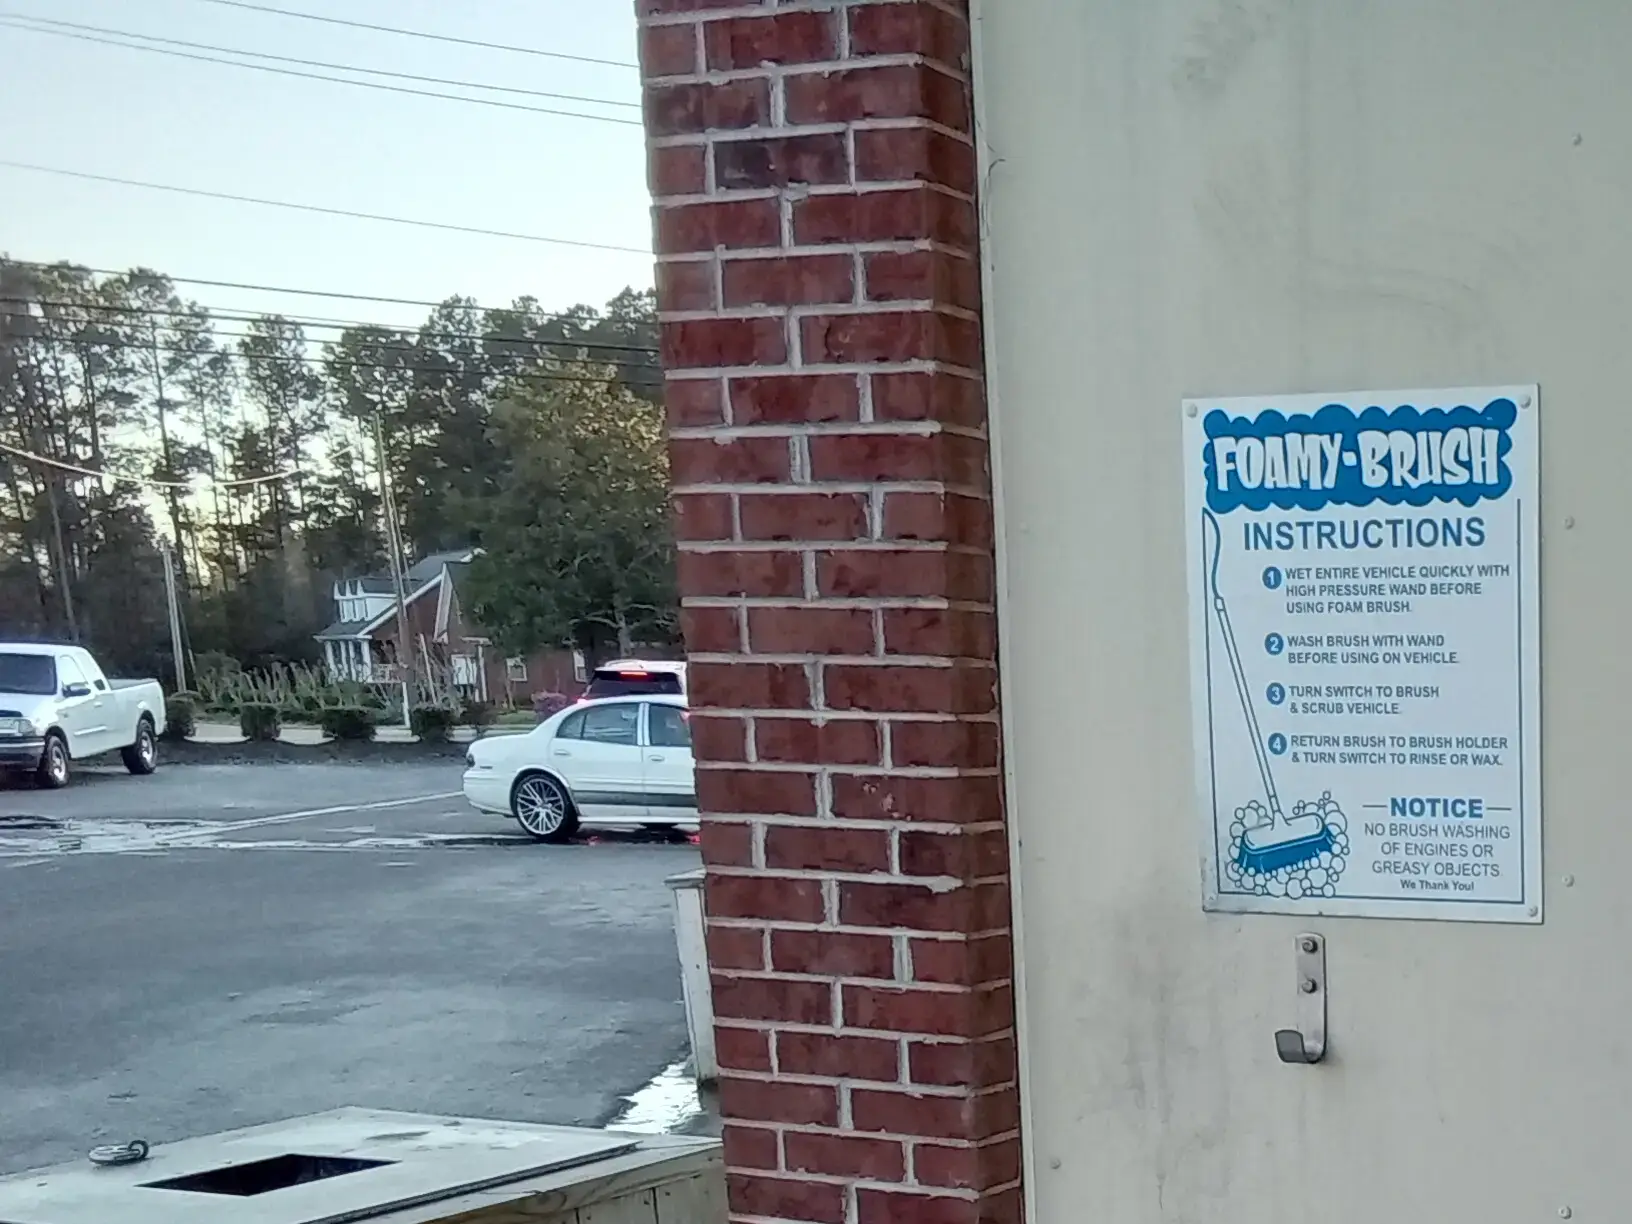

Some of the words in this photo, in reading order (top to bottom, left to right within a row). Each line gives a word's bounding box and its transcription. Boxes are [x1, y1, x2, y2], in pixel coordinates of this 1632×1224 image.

[1244, 517, 1485, 550] INSTRUCTIONS
[1285, 567, 1313, 580] WET
[1316, 567, 1360, 580] ENTIRE
[1363, 566, 1416, 579] VEHICLE
[1419, 565, 1474, 578] QUICKLY
[1477, 564, 1509, 577] WITH
[1286, 585, 1316, 597] HIGH
[1319, 584, 1387, 596] PRESSURE
[1389, 583, 1427, 595] WAND
[1430, 582, 1481, 595] BEFORE
[1286, 602, 1324, 614] USING
[1327, 602, 1364, 614] FOAM
[1287, 636, 1324, 648] WASH
[1327, 635, 1370, 648] BRUSH
[1372, 635, 1403, 647] WITH
[1406, 635, 1444, 647] WAND
[1288, 652, 1337, 664] BEFORE
[1341, 652, 1379, 664] USING
[1382, 652, 1401, 664] ON
[1289, 686, 1322, 698] TURN
[1325, 686, 1373, 698] SWITCH
[1375, 686, 1393, 698] TO
[1396, 686, 1439, 698] BRUSH
[1290, 703, 1299, 714] &
[1302, 703, 1344, 714] SCRUB
[1291, 735, 1340, 747] RETURN
[1343, 736, 1387, 748] BRUSH
[1389, 737, 1406, 748] TO
[1409, 737, 1453, 748] BRUSH
[1456, 737, 1508, 749] HOLDER
[1291, 752, 1300, 763] &
[1303, 752, 1336, 764] TURN
[1339, 752, 1387, 764] SWITCH
[1389, 753, 1407, 765] TO
[1410, 753, 1447, 765] RINSE
[1450, 754, 1469, 765] OR
[1391, 798, 1483, 818] NOTICE
[1364, 823, 1386, 836] NO
[1389, 824, 1439, 837] BRUSH
[1442, 824, 1510, 839] WASHING
[1381, 842, 1400, 855] OF
[1404, 843, 1469, 857] ENGINES
[1472, 844, 1493, 857] OR
[1372, 861, 1430, 875] GREASY
[1400, 879, 1416, 889] We
[1418, 880, 1448, 890] Thank
